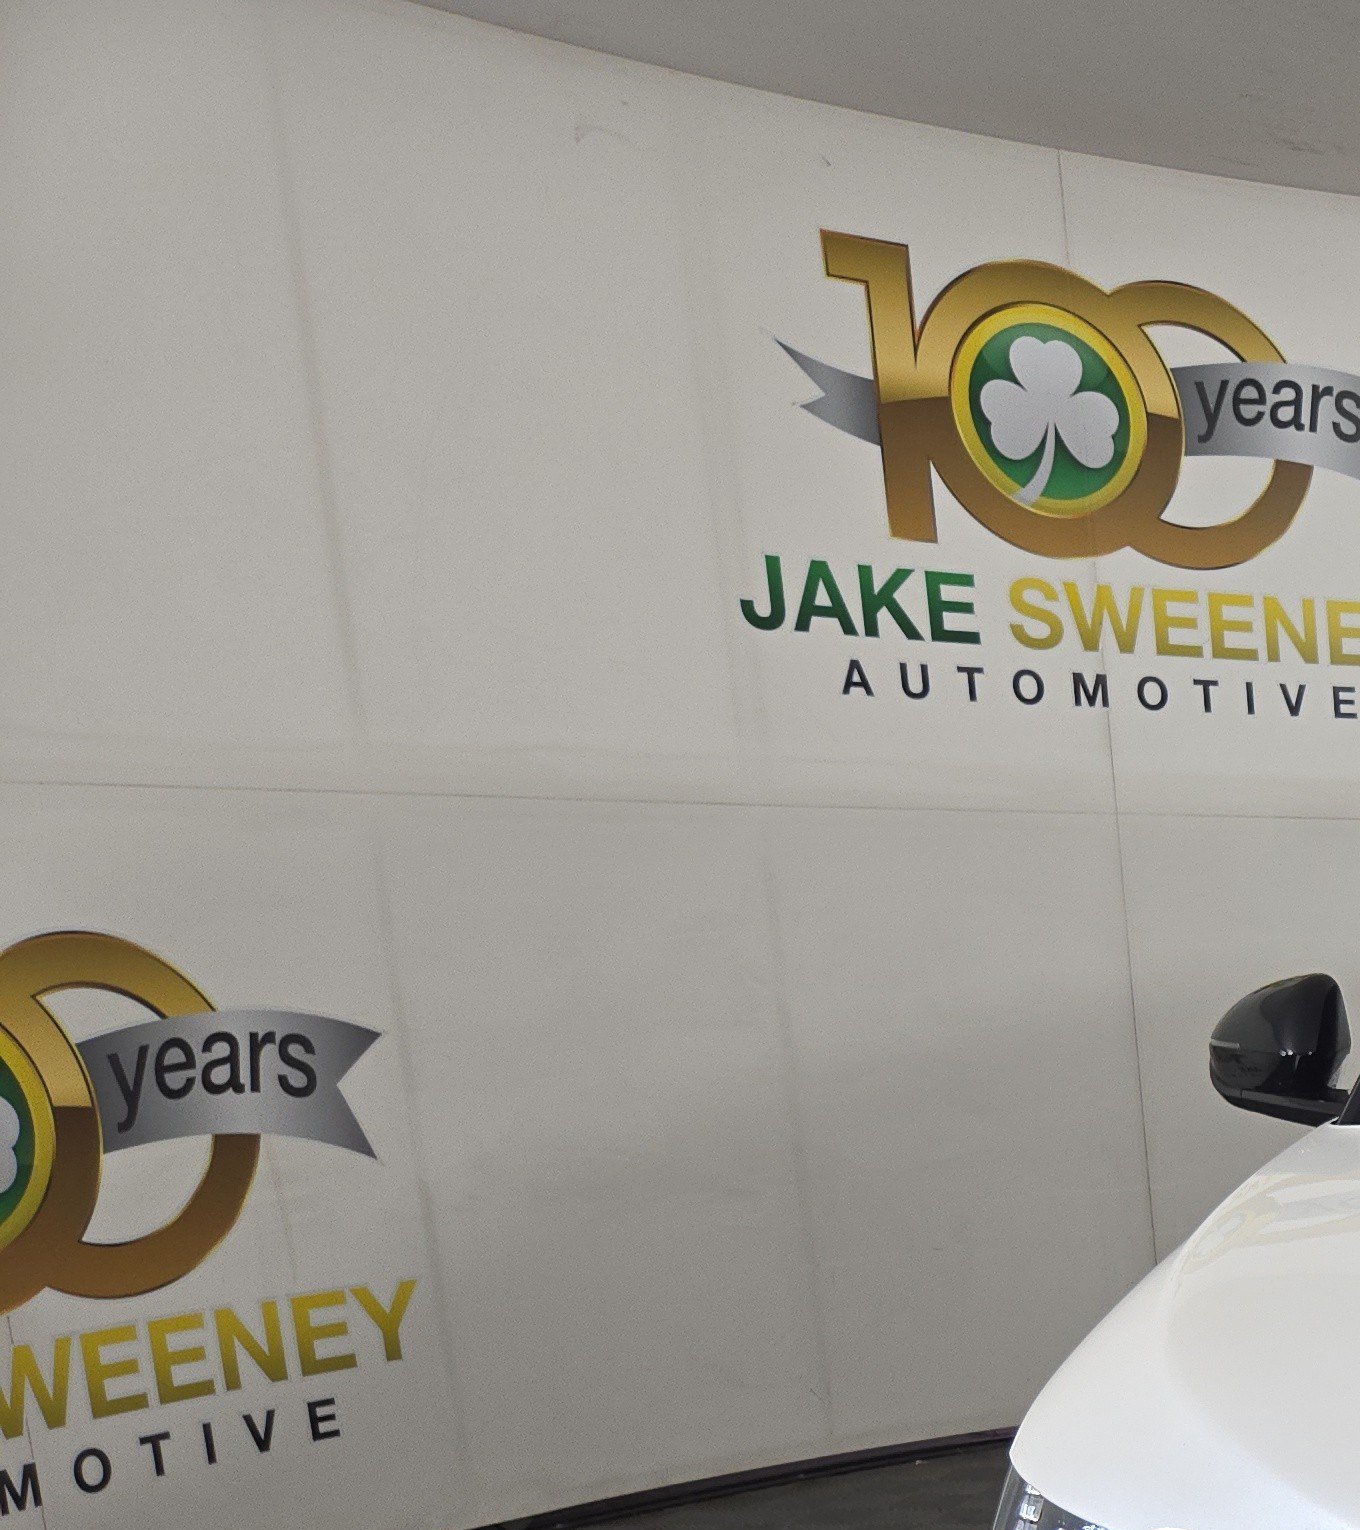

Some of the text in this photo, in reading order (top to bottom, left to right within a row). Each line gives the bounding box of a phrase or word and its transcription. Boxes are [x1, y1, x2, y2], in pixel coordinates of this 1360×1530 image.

[739, 554, 981, 646] JAKE
[842, 659, 1358, 719] AUTOMOTIVE
[107, 1029, 318, 1134] years
